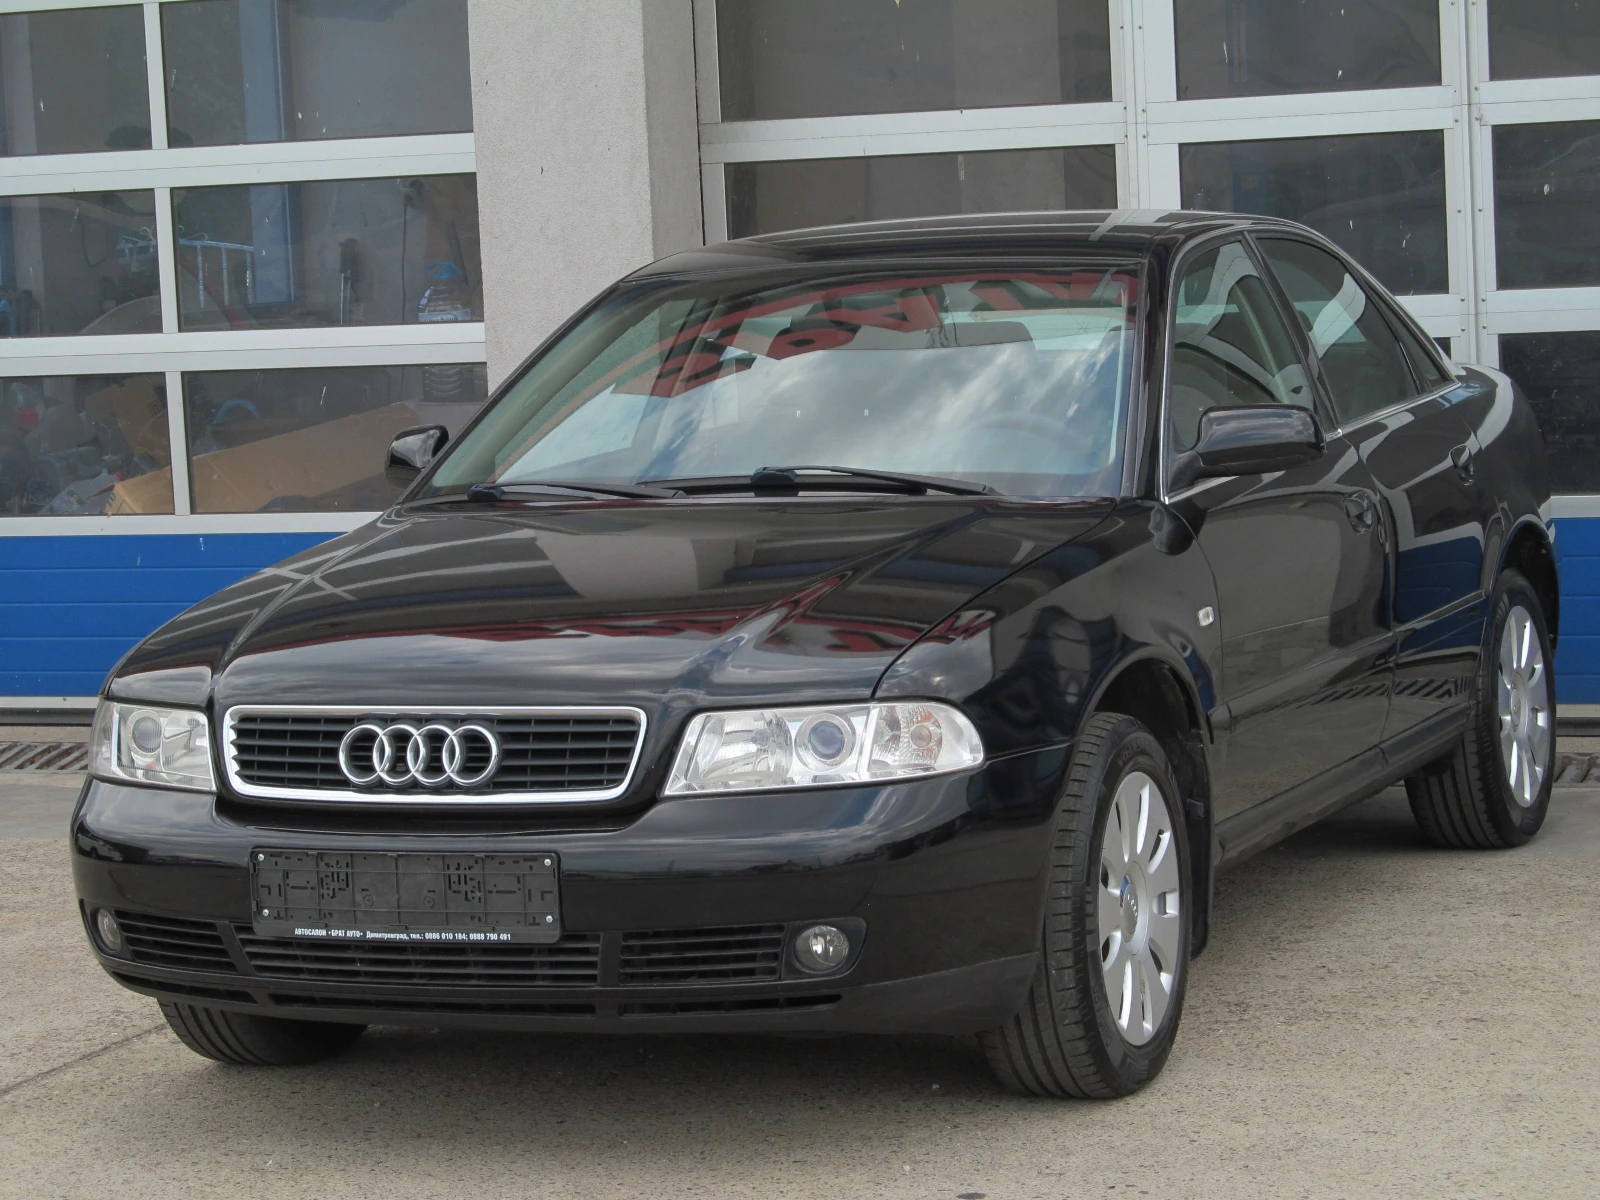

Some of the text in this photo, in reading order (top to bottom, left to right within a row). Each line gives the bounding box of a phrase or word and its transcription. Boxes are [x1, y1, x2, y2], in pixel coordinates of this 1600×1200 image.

[294, 927, 327, 936] АВТОСАЛОН
[441, 932, 453, 940] 010
[499, 933, 511, 941] 491
